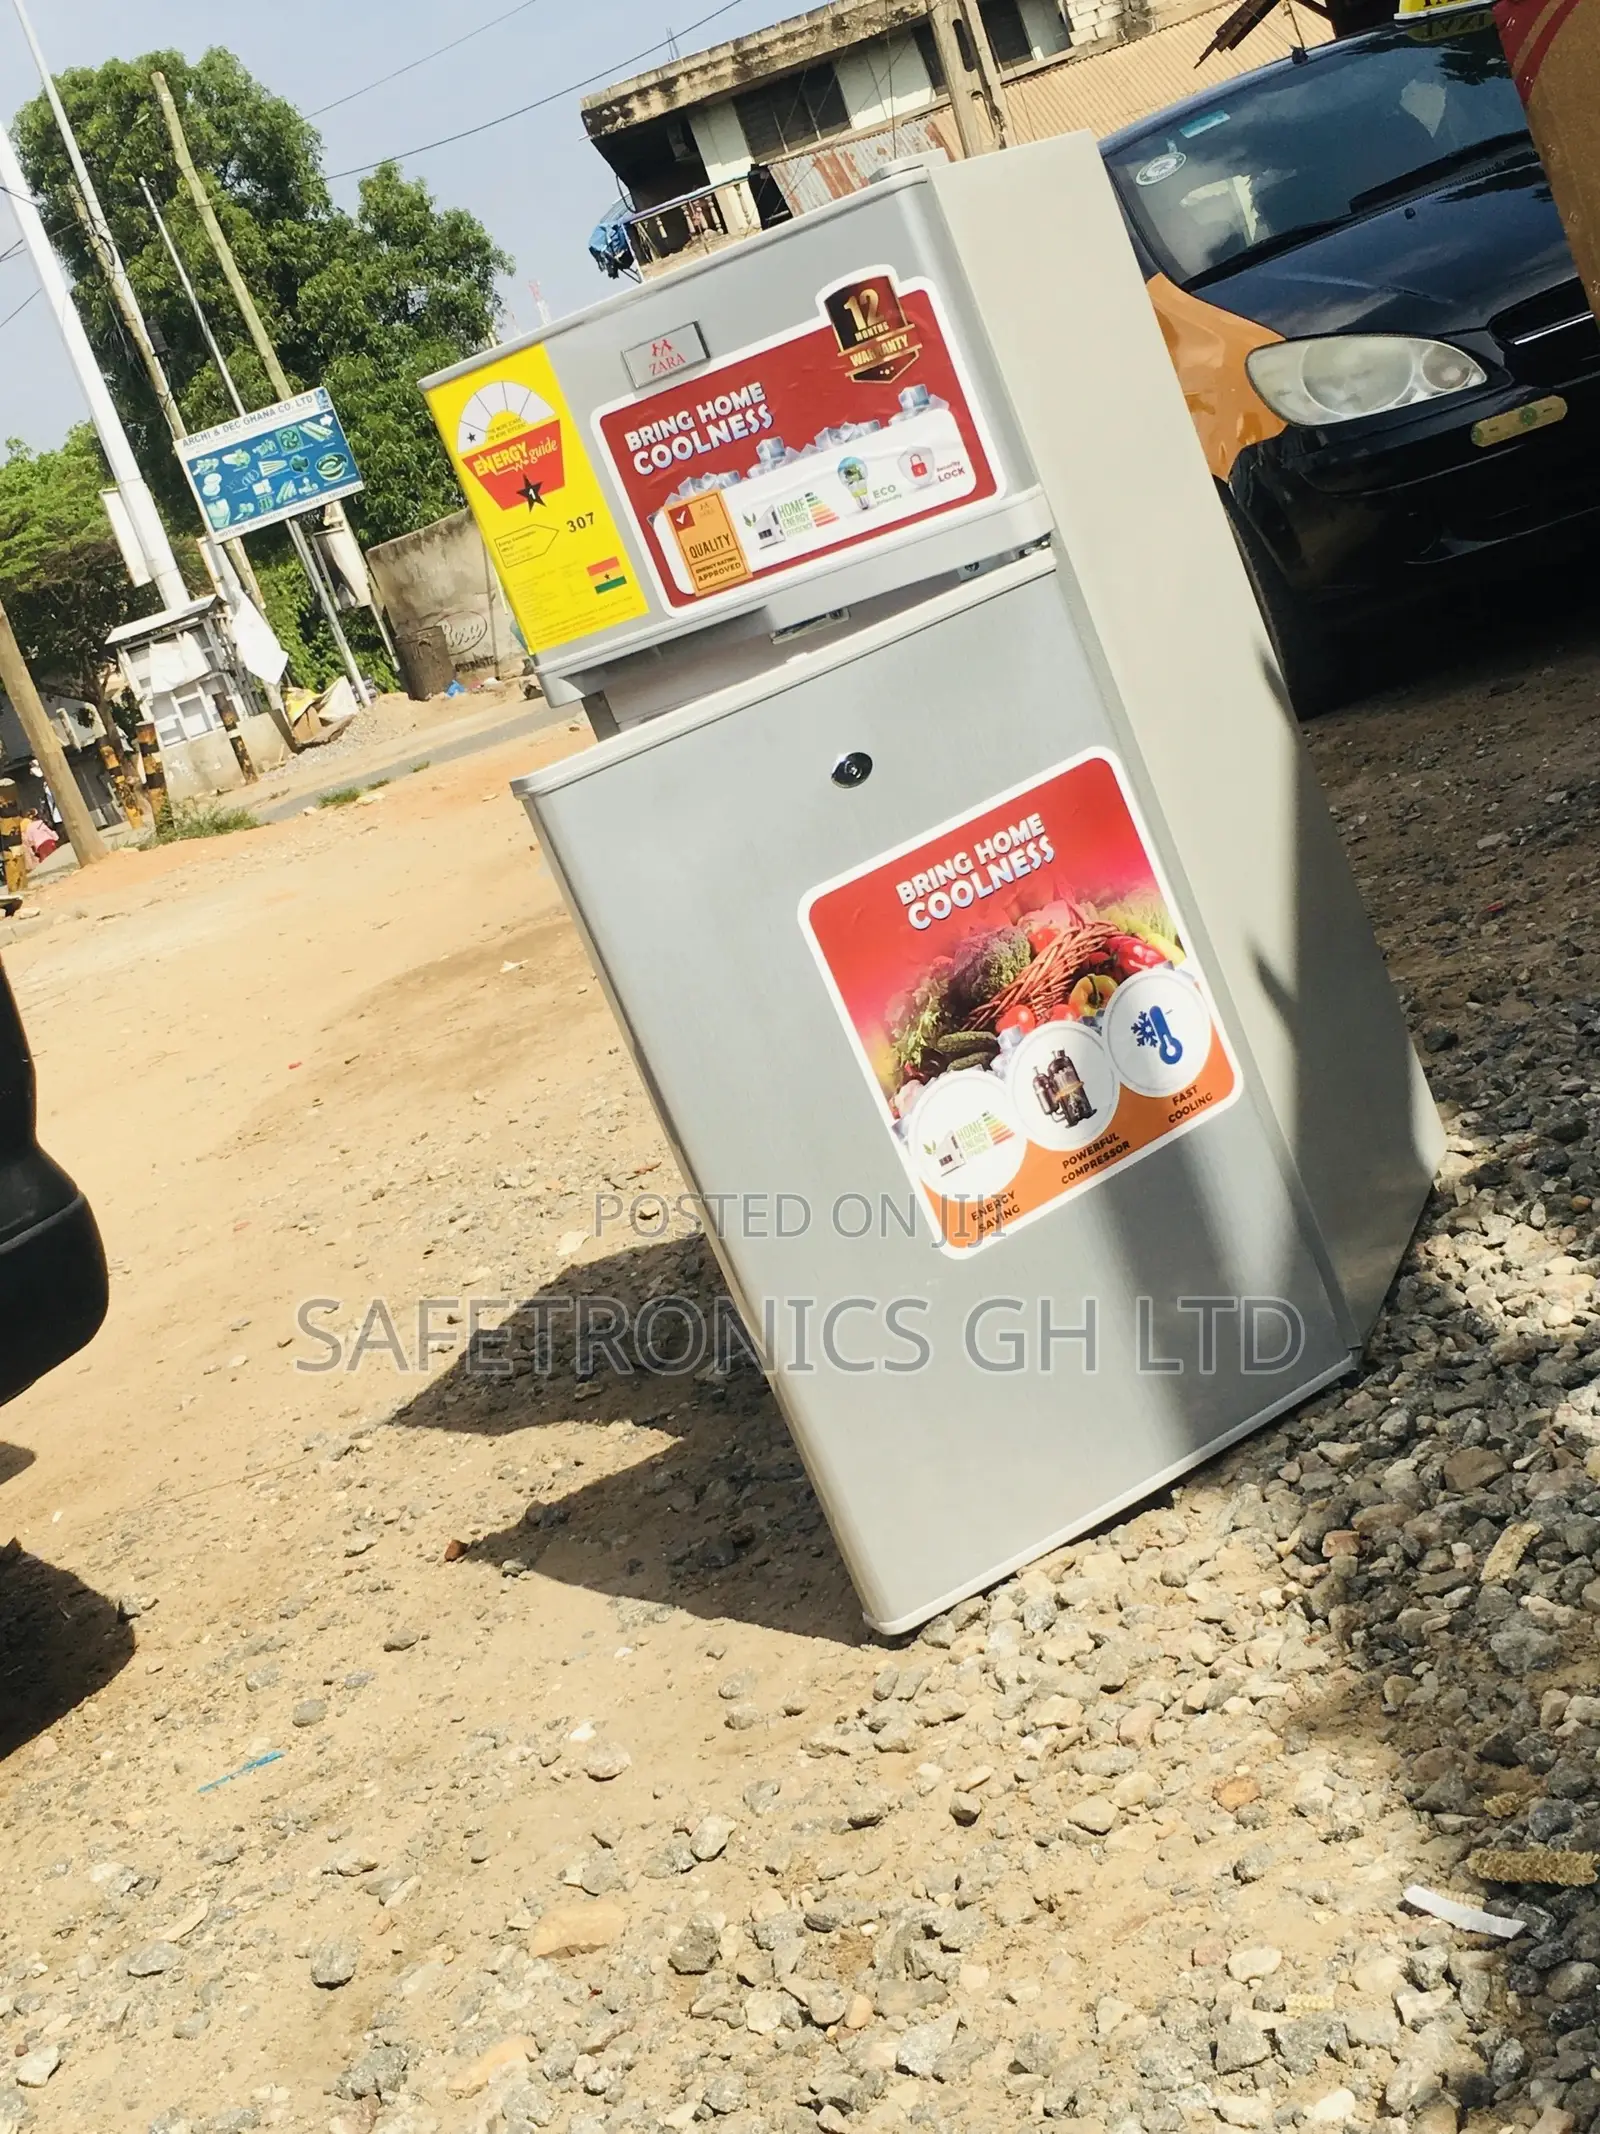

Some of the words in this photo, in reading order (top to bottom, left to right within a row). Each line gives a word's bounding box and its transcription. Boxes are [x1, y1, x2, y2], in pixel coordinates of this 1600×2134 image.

[844, 289, 884, 331] 12
[855, 321, 889, 341] MONTHS
[649, 353, 686, 376] ZARA
[182, 431, 211, 447] ARCHI
[222, 421, 241, 433] DEC
[243, 408, 276, 425] GHANA
[296, 395, 313, 407] LTD
[624, 410, 695, 452] BRING
[696, 382, 765, 423] HOME
[633, 404, 773, 475] COOLNESS
[473, 441, 528, 477] ENERGY
[529, 437, 558, 464] guide
[938, 467, 966, 482] LOCK
[529, 488, 536, 500] 1
[872, 484, 896, 499] ECO
[566, 512, 594, 533] 307
[778, 498, 806, 518] HOME
[781, 513, 810, 530] ENERGY
[689, 533, 731, 559] QUALITY
[698, 562, 742, 582] APPROVED
[896, 852, 975, 906] BRING
[973, 813, 1046, 865] HOME
[908, 835, 1055, 930] COOLNESS
[1168, 1092, 1213, 1123] COOLING
[1172, 1085, 1198, 1106] FAST
[1061, 1140, 1131, 1184] COMPRESSOR
[1062, 1132, 1121, 1169] POWERFUL
[970, 1190, 1016, 1222] ENERGY
[978, 1204, 1021, 1233] SAVING
